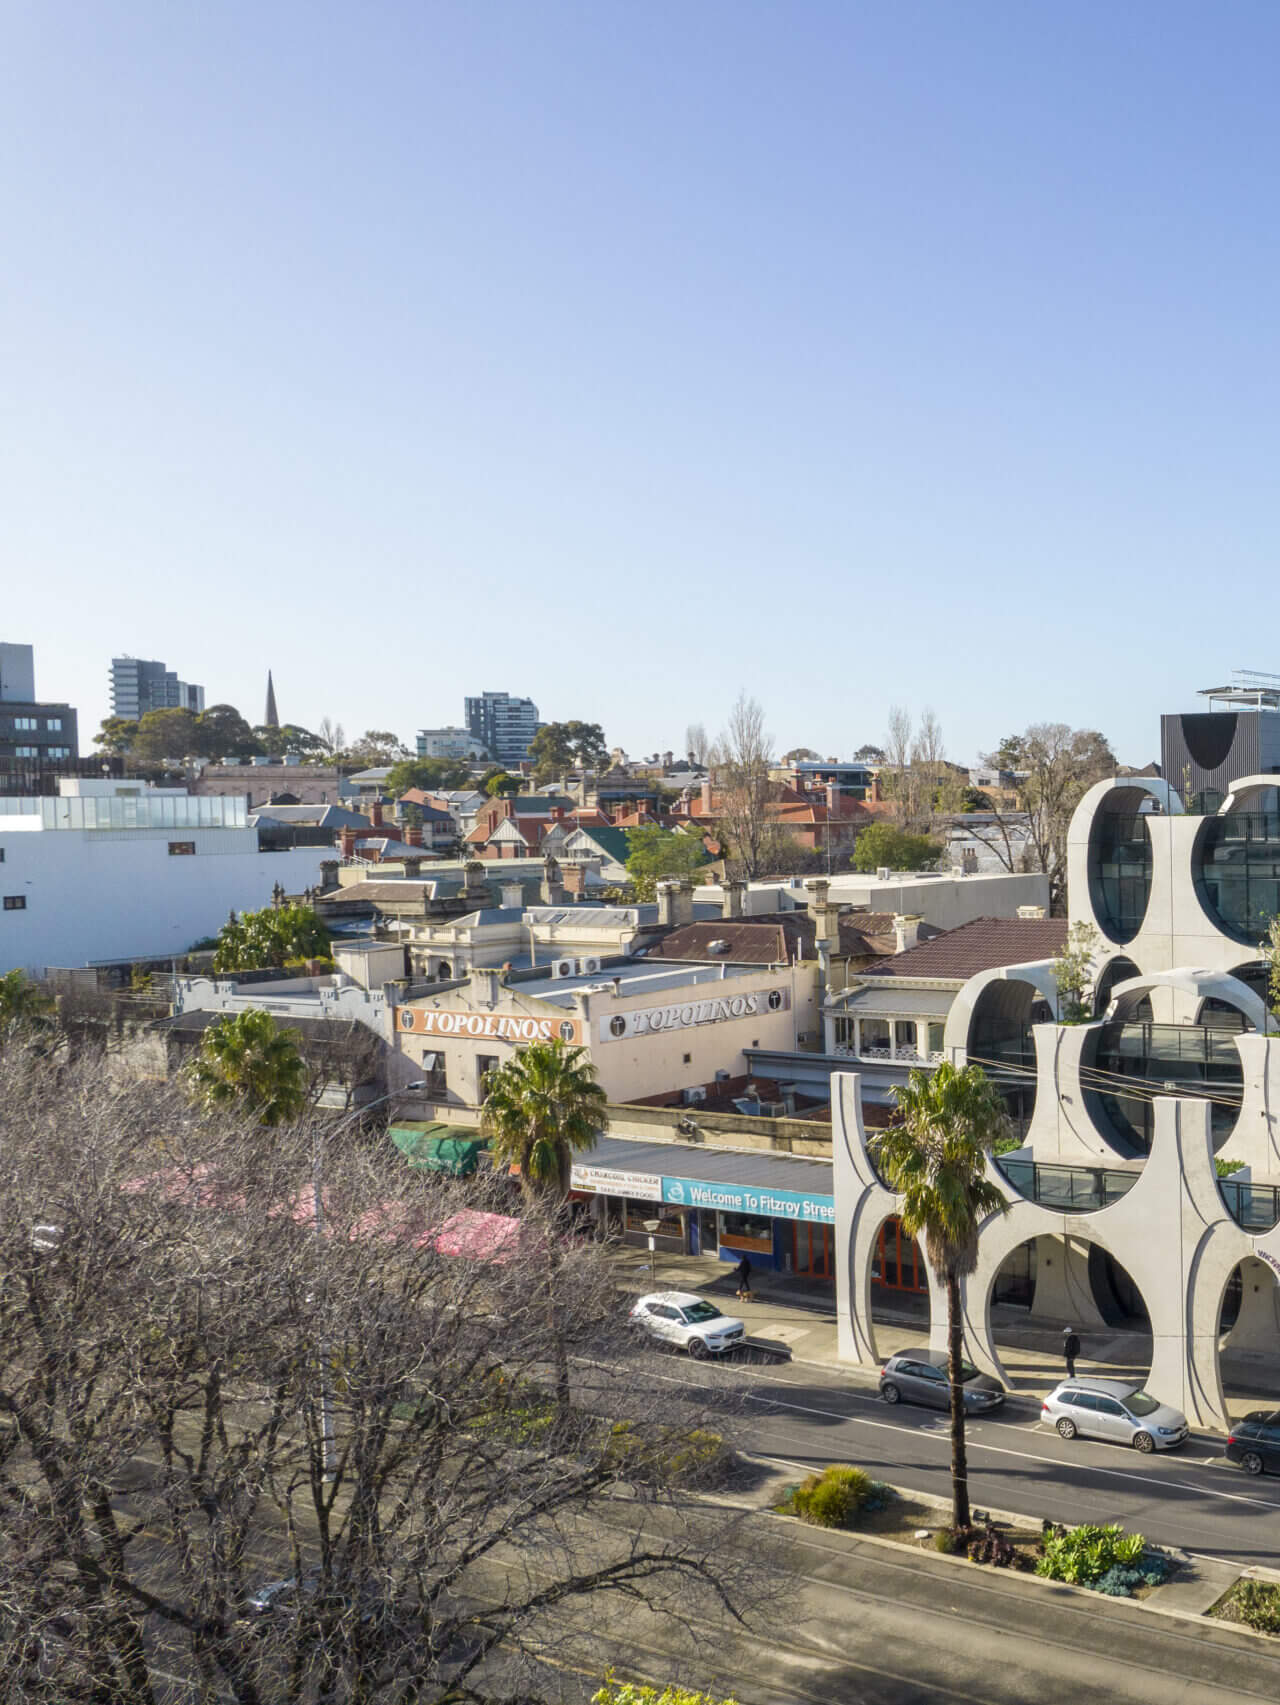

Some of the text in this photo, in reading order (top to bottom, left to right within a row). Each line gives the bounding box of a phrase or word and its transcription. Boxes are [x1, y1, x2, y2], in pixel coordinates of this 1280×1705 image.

[423, 1011, 552, 1040] TOPOLINOS
[633, 995, 758, 1034] TOPOLINOS
[690, 1187, 742, 1206] Welcome
[744, 1193, 758, 1208] To
[760, 1196, 800, 1217] Fitzroy
